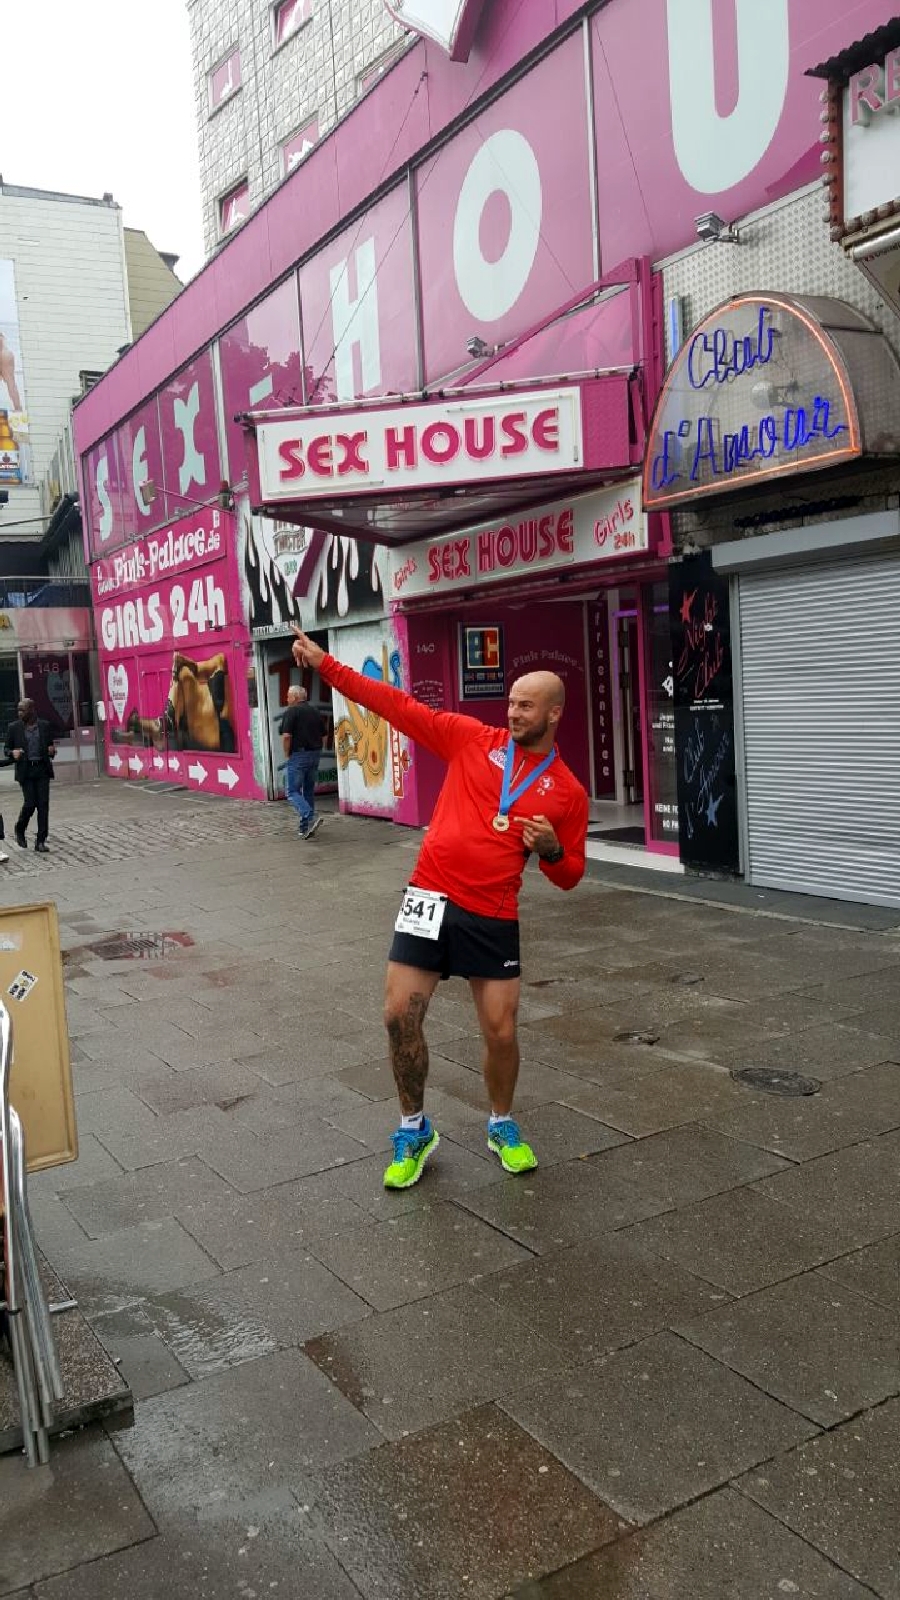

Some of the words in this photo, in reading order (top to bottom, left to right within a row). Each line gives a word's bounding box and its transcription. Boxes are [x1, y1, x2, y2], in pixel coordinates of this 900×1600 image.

[279, 430, 370, 482] SEX
[384, 407, 560, 471] HOUSE
[428, 535, 471, 583] SEX
[477, 508, 575, 573] HOUSE
[592, 499, 634, 547] Girls
[101, 591, 165, 652] GIRLS
[169, 574, 226, 638] 24h
